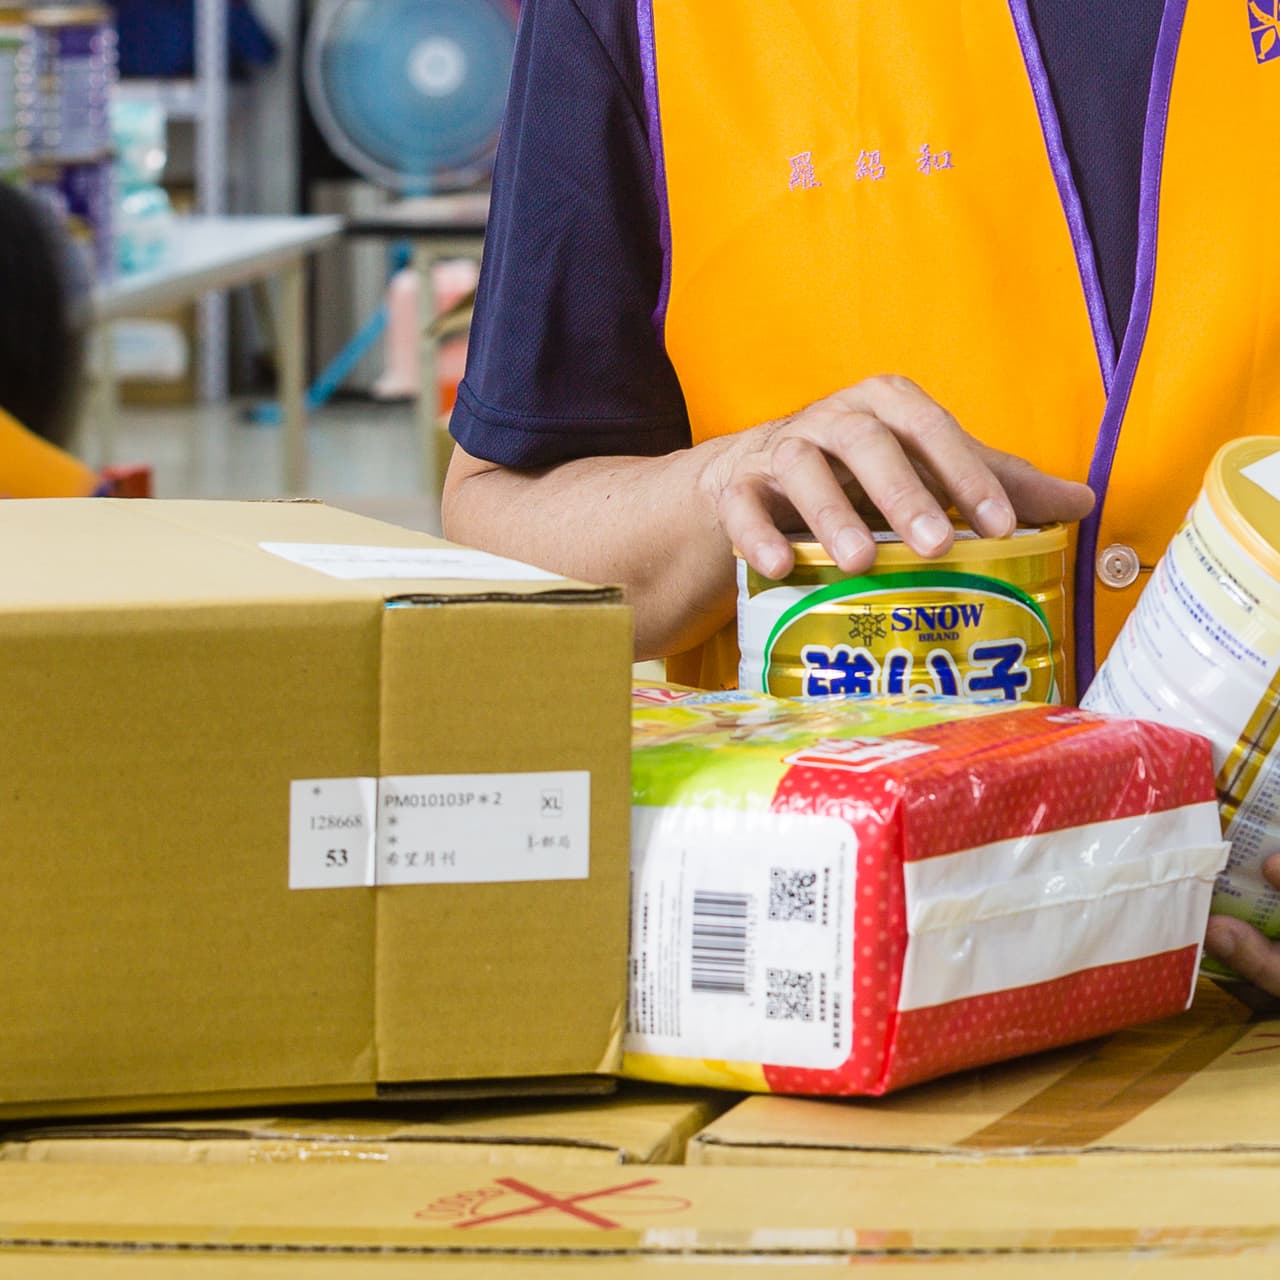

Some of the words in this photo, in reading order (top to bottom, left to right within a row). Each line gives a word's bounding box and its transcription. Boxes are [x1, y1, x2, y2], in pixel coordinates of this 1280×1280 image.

[890, 602, 985, 633] SNOW
[917, 630, 961, 643] BRAND
[540, 796, 562, 811] XL
[324, 847, 349, 868] 53
